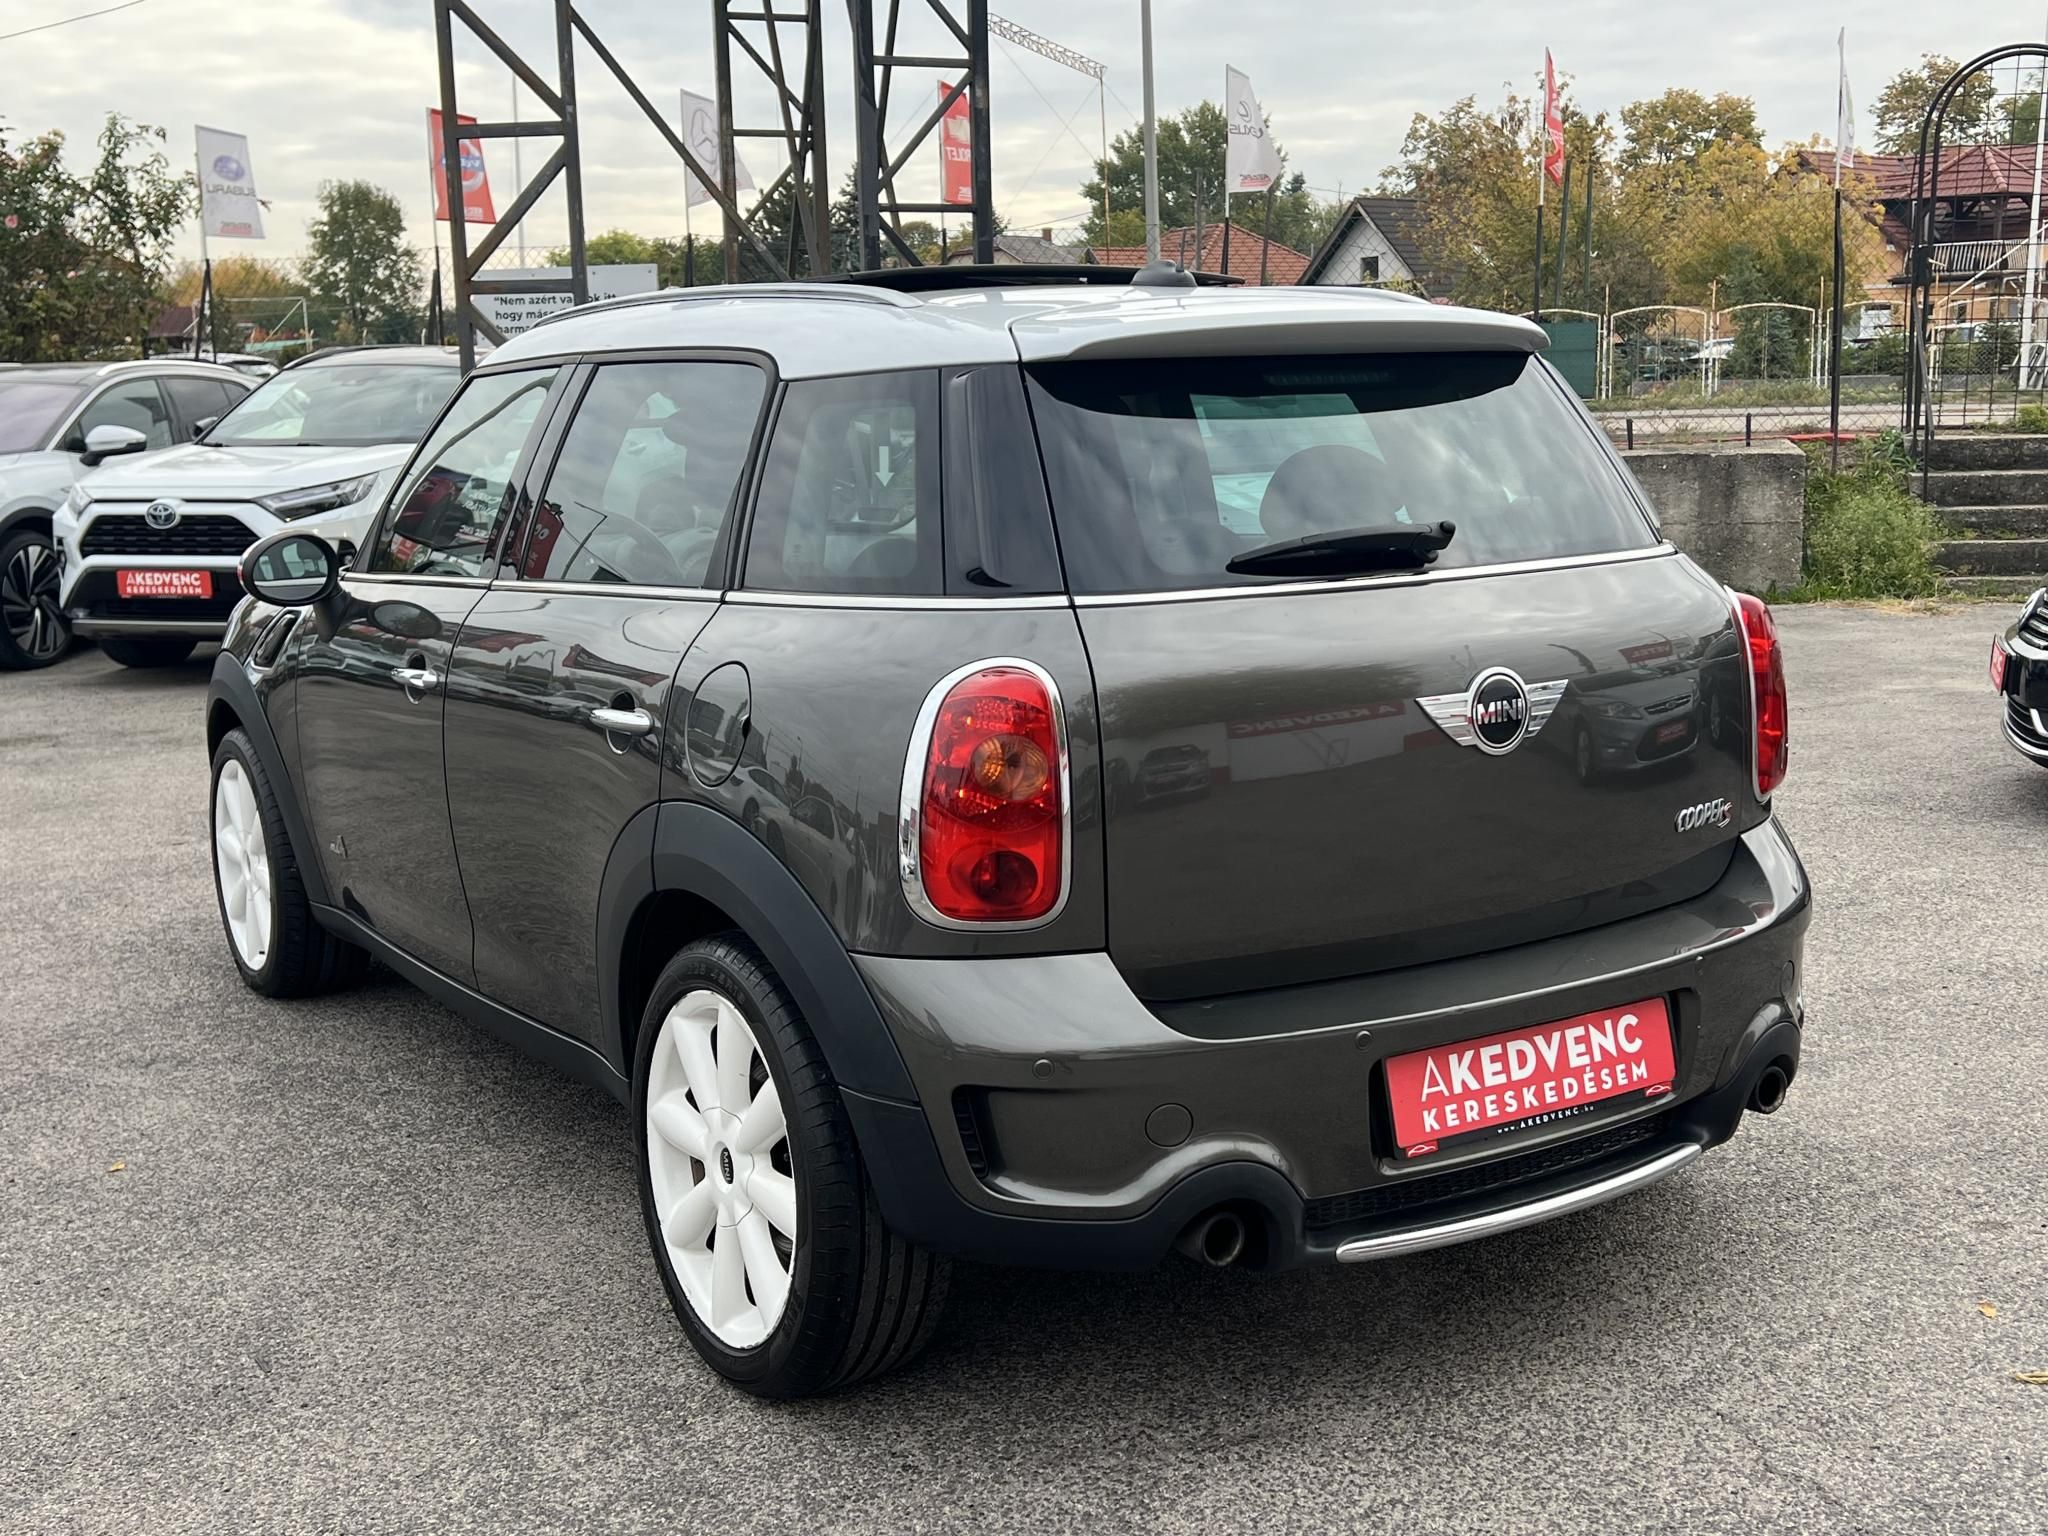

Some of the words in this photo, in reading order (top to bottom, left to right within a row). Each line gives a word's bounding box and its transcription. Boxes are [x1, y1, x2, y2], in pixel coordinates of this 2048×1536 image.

[528, 295, 557, 305] azért
[495, 310, 523, 321] hogy
[1476, 698, 1522, 725] MINI
[1422, 1058, 1648, 1133] KERESKEDÉSEM
[723, 1151, 731, 1181] MINI
